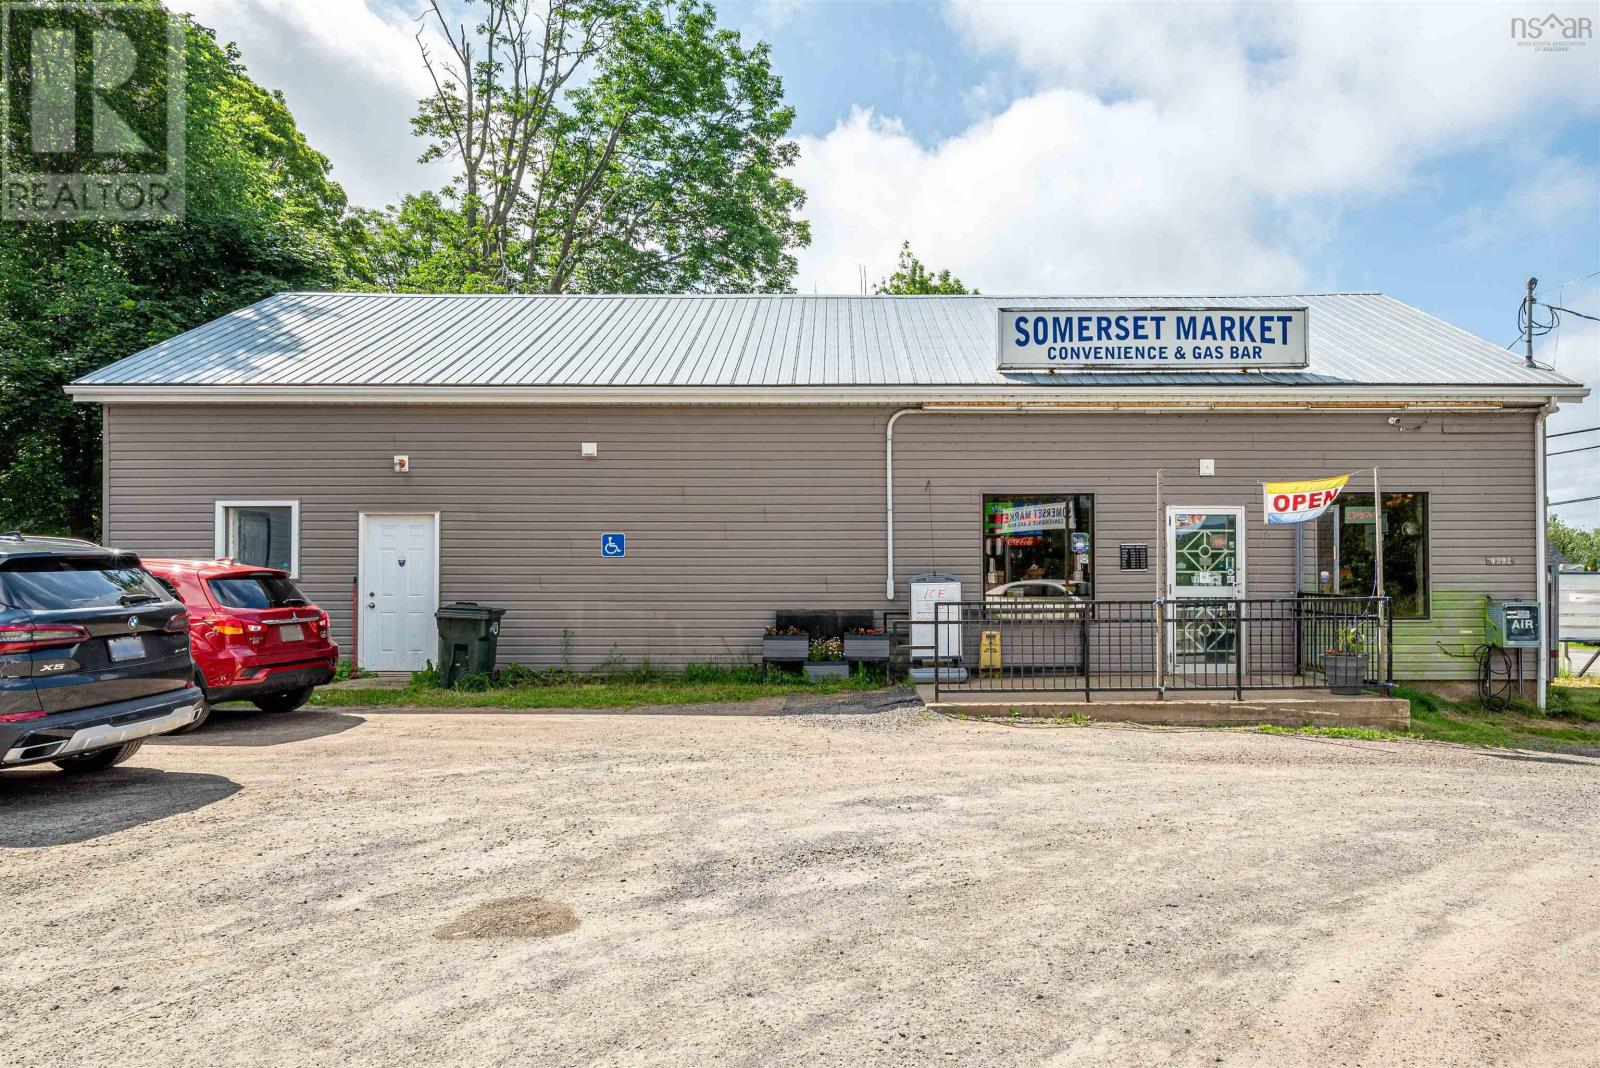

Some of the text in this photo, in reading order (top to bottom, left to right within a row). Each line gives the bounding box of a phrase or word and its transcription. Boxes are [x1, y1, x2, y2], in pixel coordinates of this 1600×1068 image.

[1015, 315, 1292, 347] SOMERSET MARKET
[1047, 346, 1262, 360] CONVENIENCE & GAS BAR
[1273, 488, 1338, 512] OPEN
[1347, 511, 1374, 521] OPEN
[924, 589, 946, 600] ICE
[1511, 619, 1534, 629] AIR
[40, 663, 65, 672] X5
